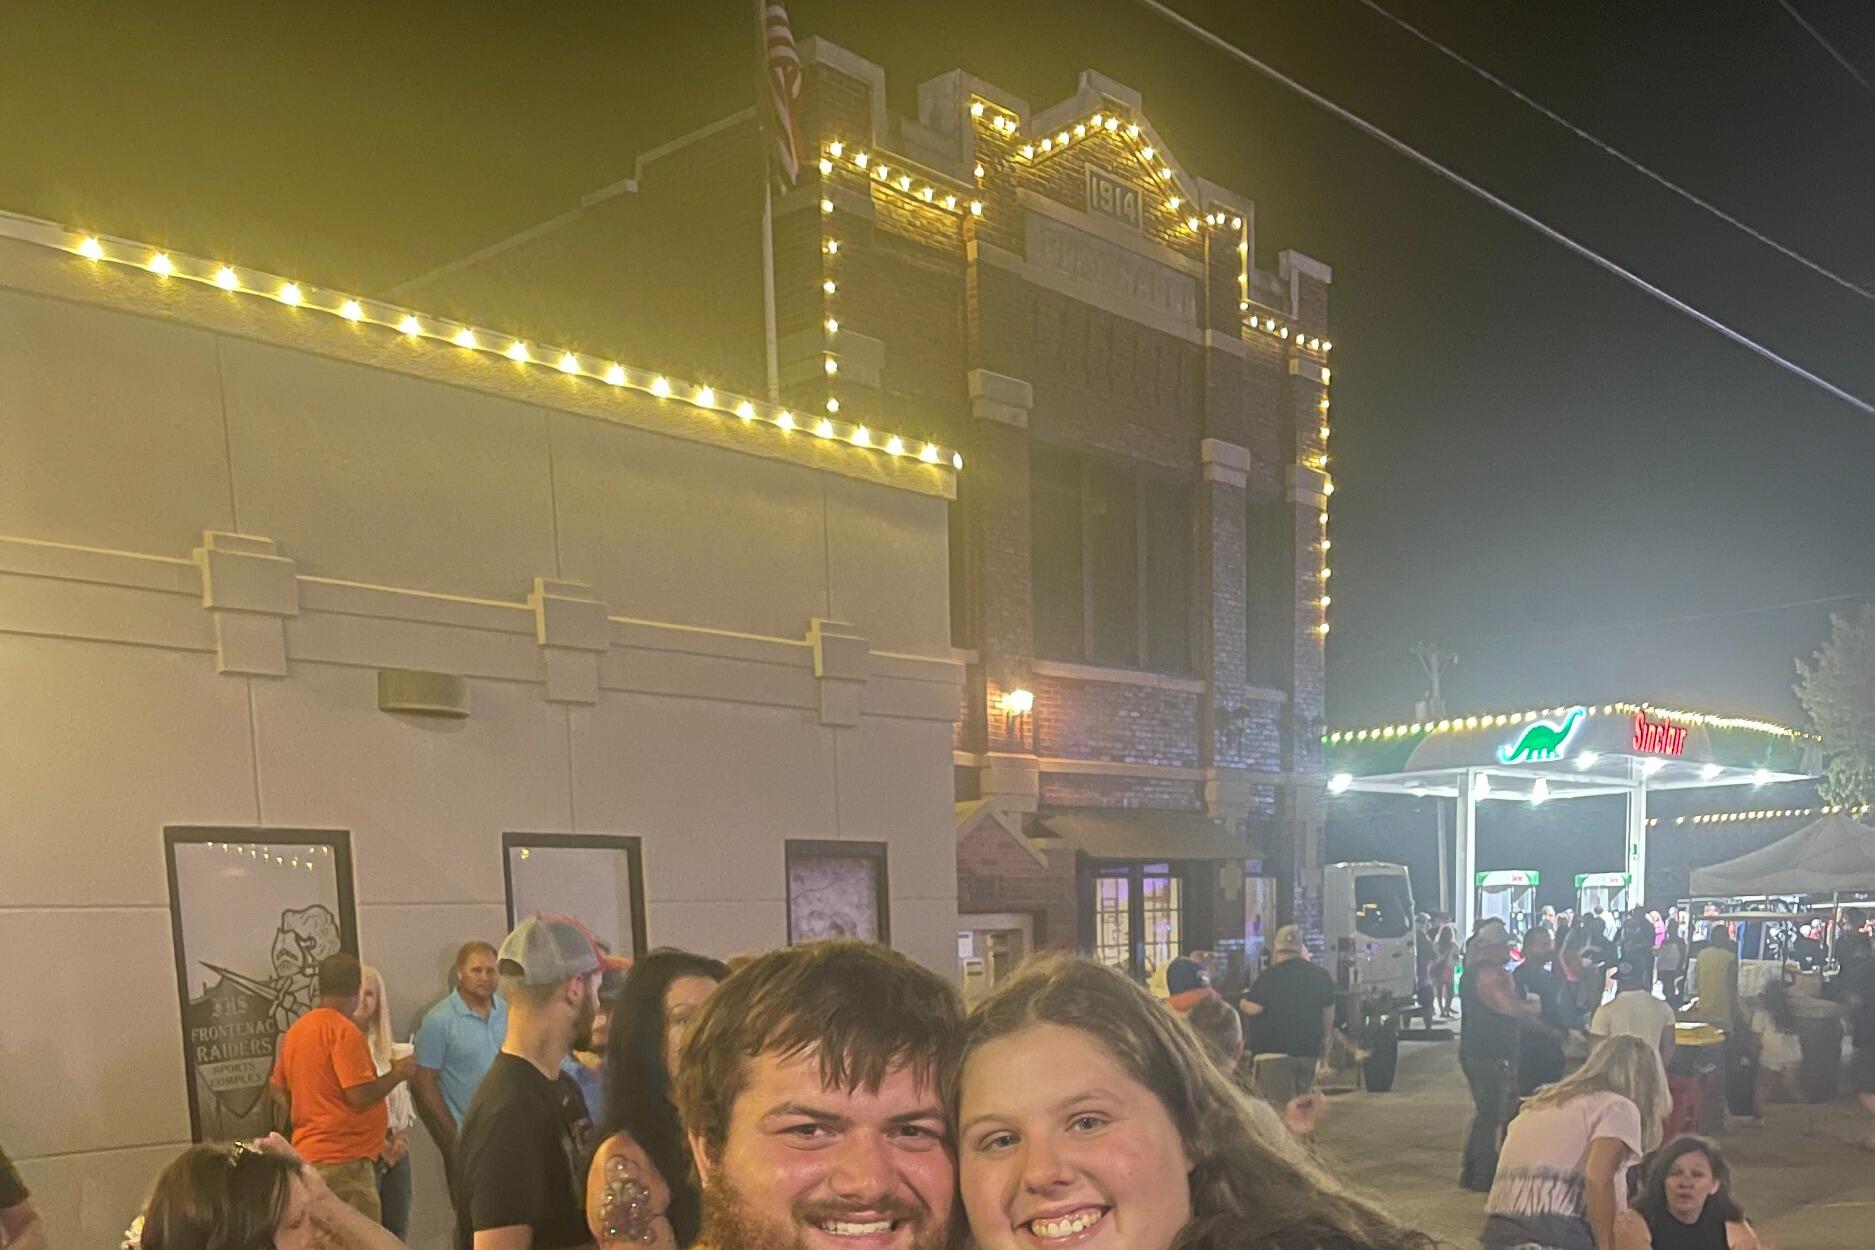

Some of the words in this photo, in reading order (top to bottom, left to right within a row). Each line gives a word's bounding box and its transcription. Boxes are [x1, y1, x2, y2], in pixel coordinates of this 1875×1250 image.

[1092, 176, 1136, 222] 1914
[1633, 710, 1688, 756] Sinclair
[191, 1019, 275, 1042] FRONTENAC
[197, 1037, 272, 1062] RAIDERS
